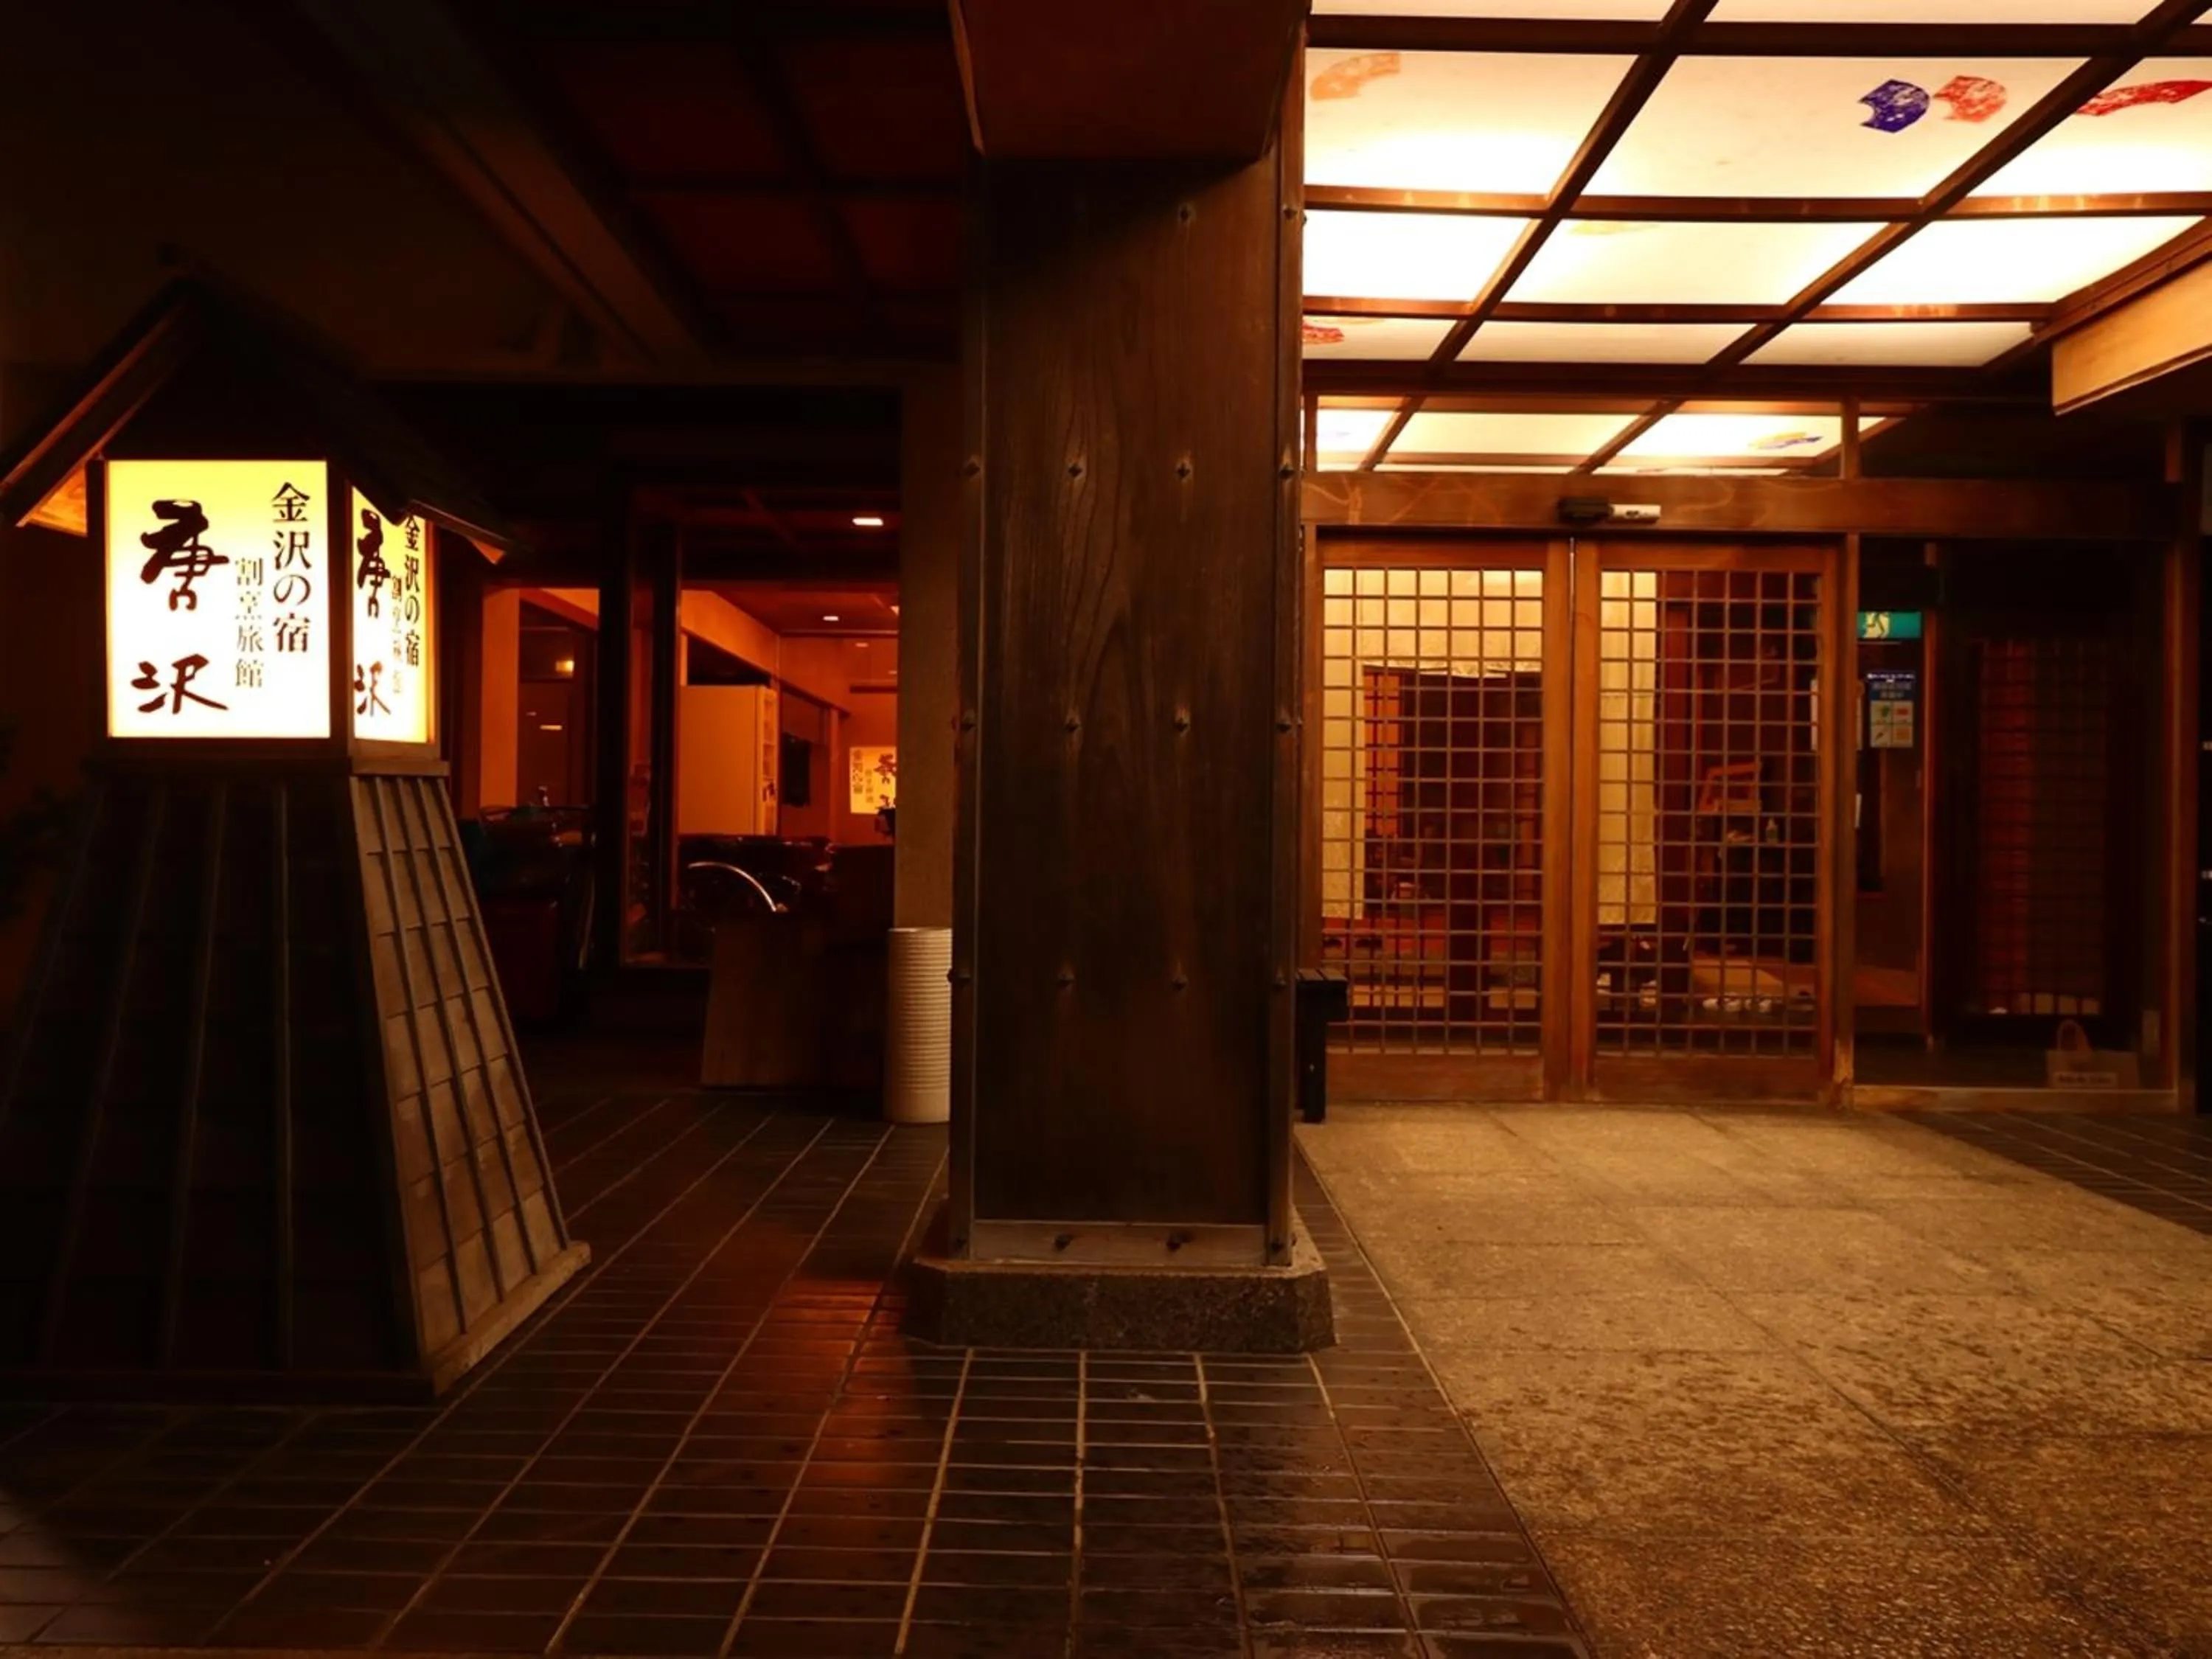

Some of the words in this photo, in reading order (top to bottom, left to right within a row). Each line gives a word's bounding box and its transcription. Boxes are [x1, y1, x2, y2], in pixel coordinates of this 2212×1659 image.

[271, 481, 312, 653] 金沢の宿
[404, 517, 420, 667] 金沢の宿
